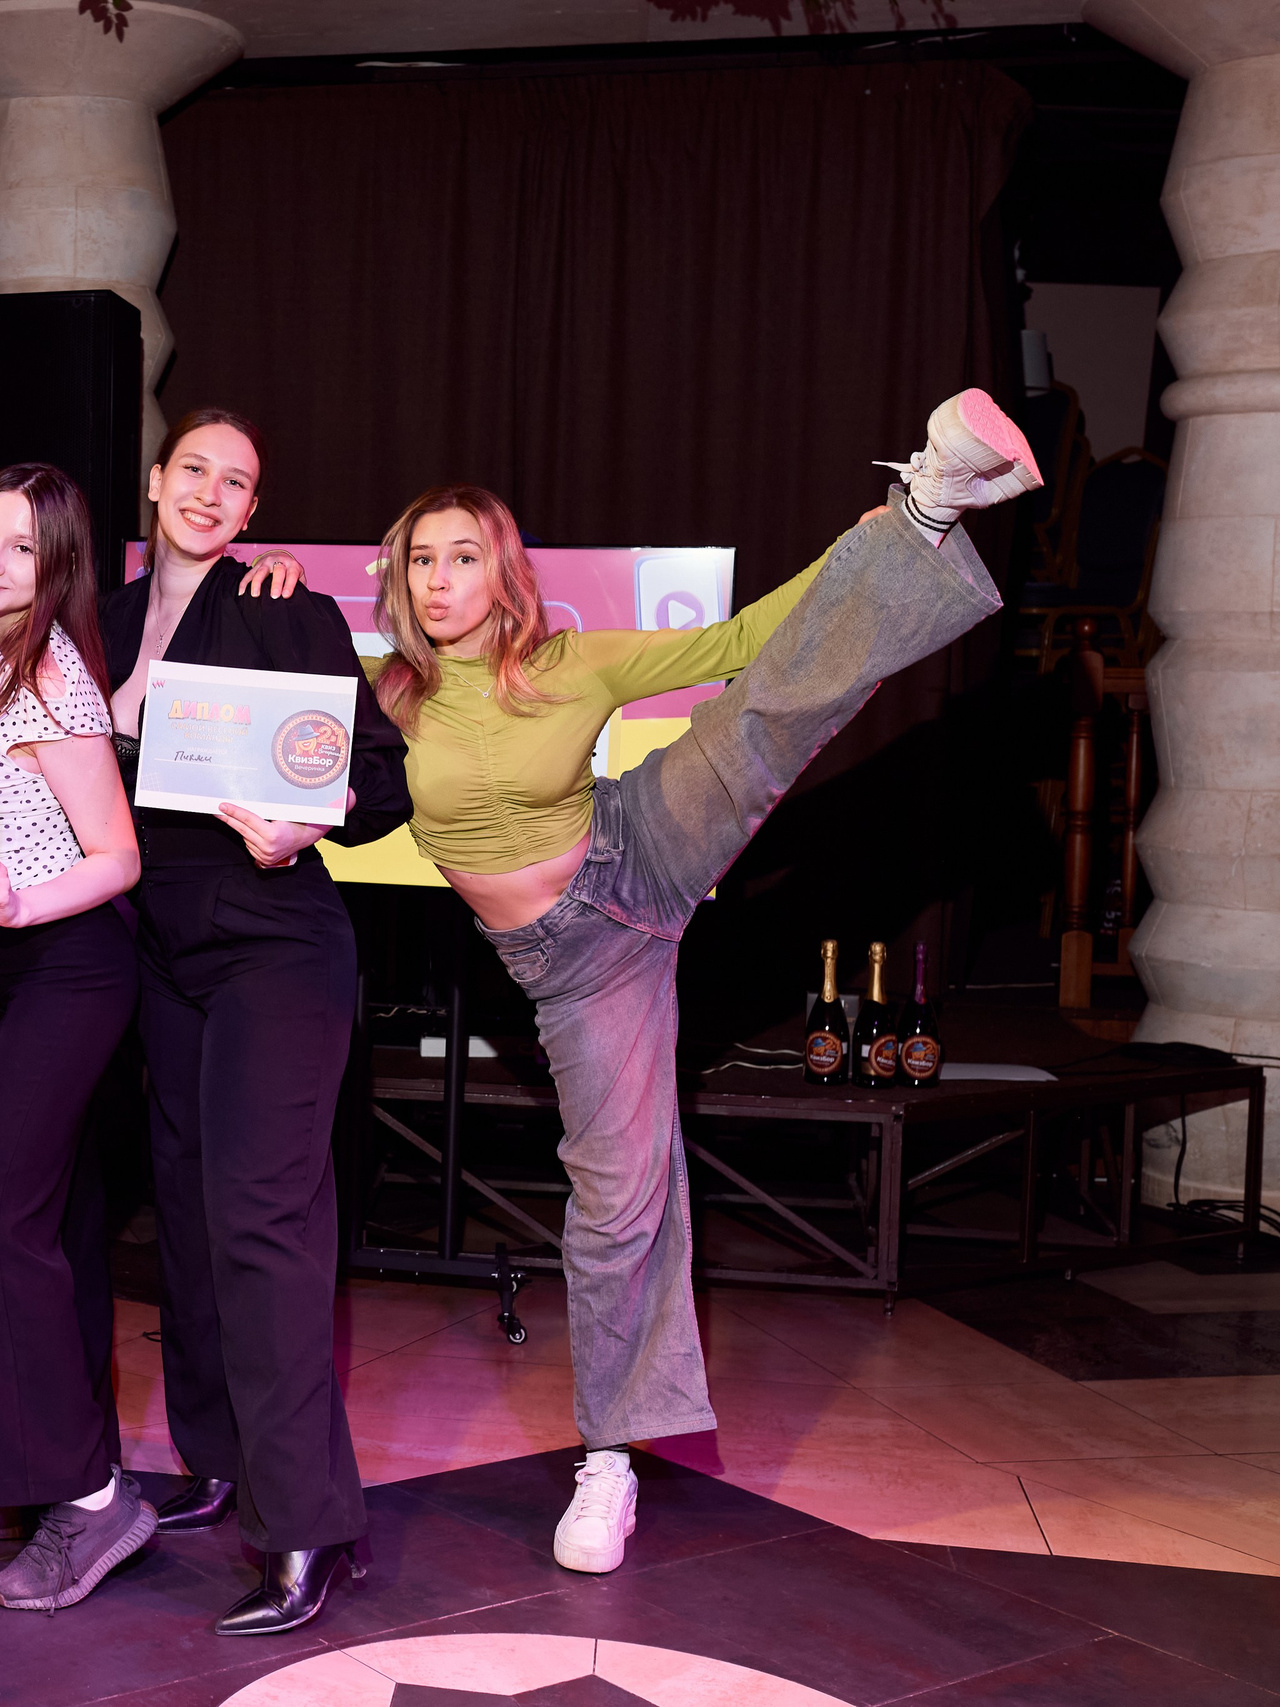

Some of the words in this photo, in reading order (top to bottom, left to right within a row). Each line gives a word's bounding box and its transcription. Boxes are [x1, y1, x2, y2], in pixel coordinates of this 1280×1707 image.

[168, 699, 251, 725] ДИПЛОМ
[288, 754, 333, 767] КвизБор
[294, 764, 325, 772] Вечеринка
